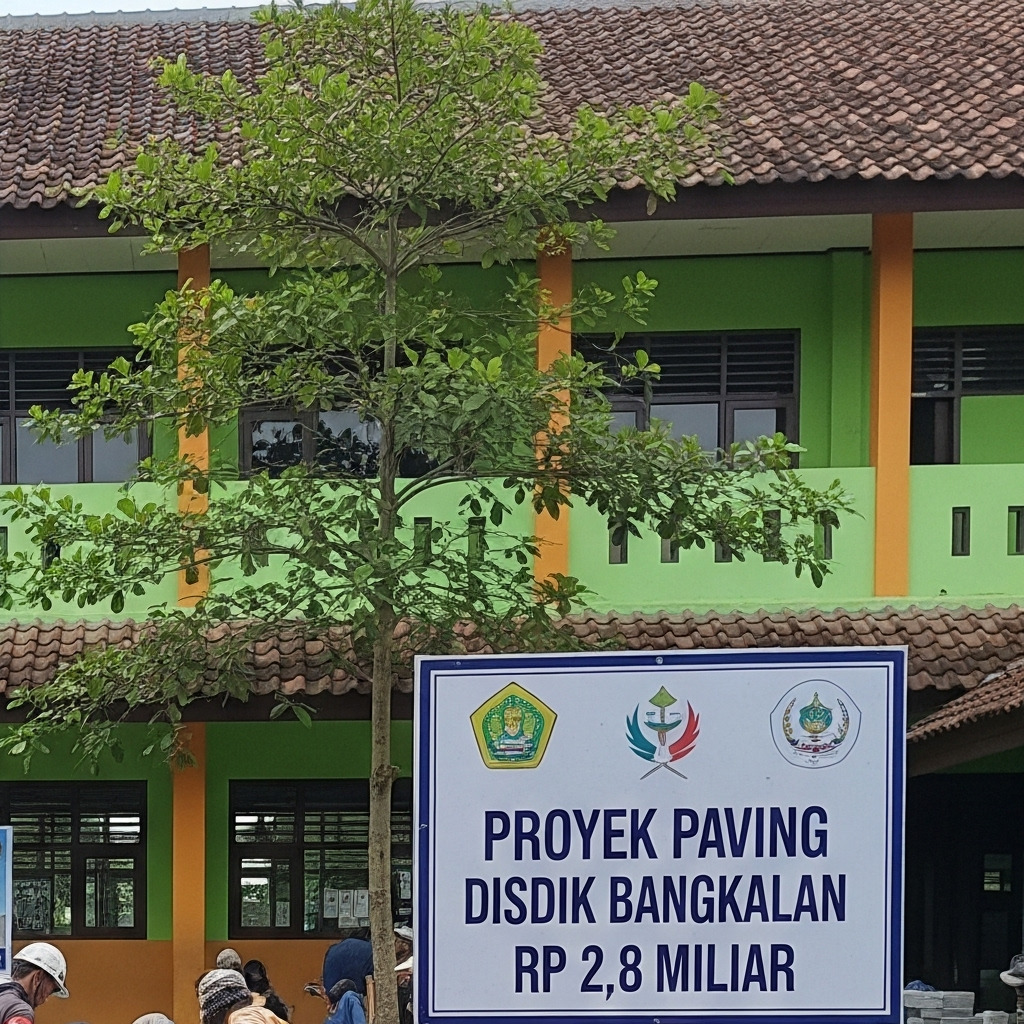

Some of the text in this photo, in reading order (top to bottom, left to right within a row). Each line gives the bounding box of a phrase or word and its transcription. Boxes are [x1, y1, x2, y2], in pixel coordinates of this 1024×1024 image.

[484, 805, 829, 862] PROYEK PAVING
[464, 873, 848, 926] DISDIK BANGKALAN
[514, 943, 795, 1002] RP 2,8 MILIAR
